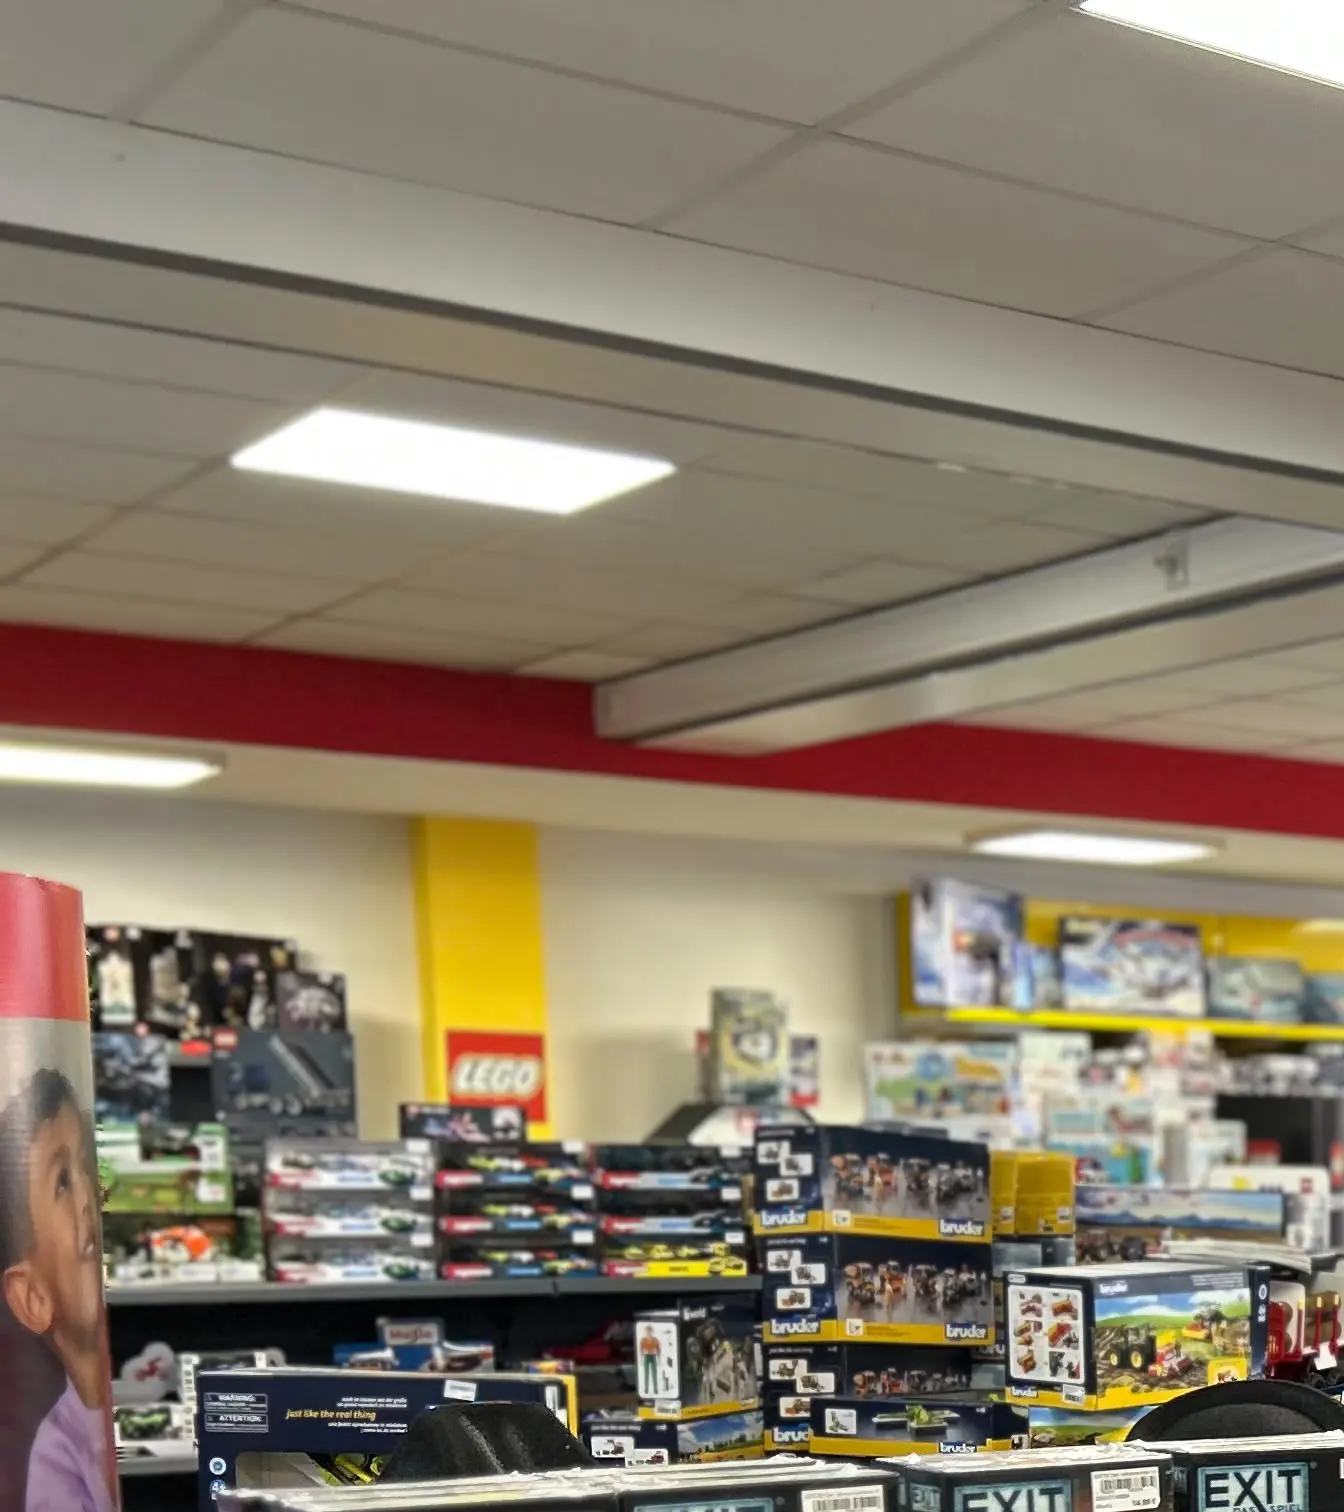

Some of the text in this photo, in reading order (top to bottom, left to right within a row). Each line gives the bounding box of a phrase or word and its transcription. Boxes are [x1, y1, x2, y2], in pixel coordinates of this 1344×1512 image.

[450, 1053, 541, 1097] LEGO
[761, 1211, 806, 1225] bruder
[771, 1319, 819, 1334] bruder
[286, 1410, 302, 1419] just
[354, 1411, 376, 1421] thing
